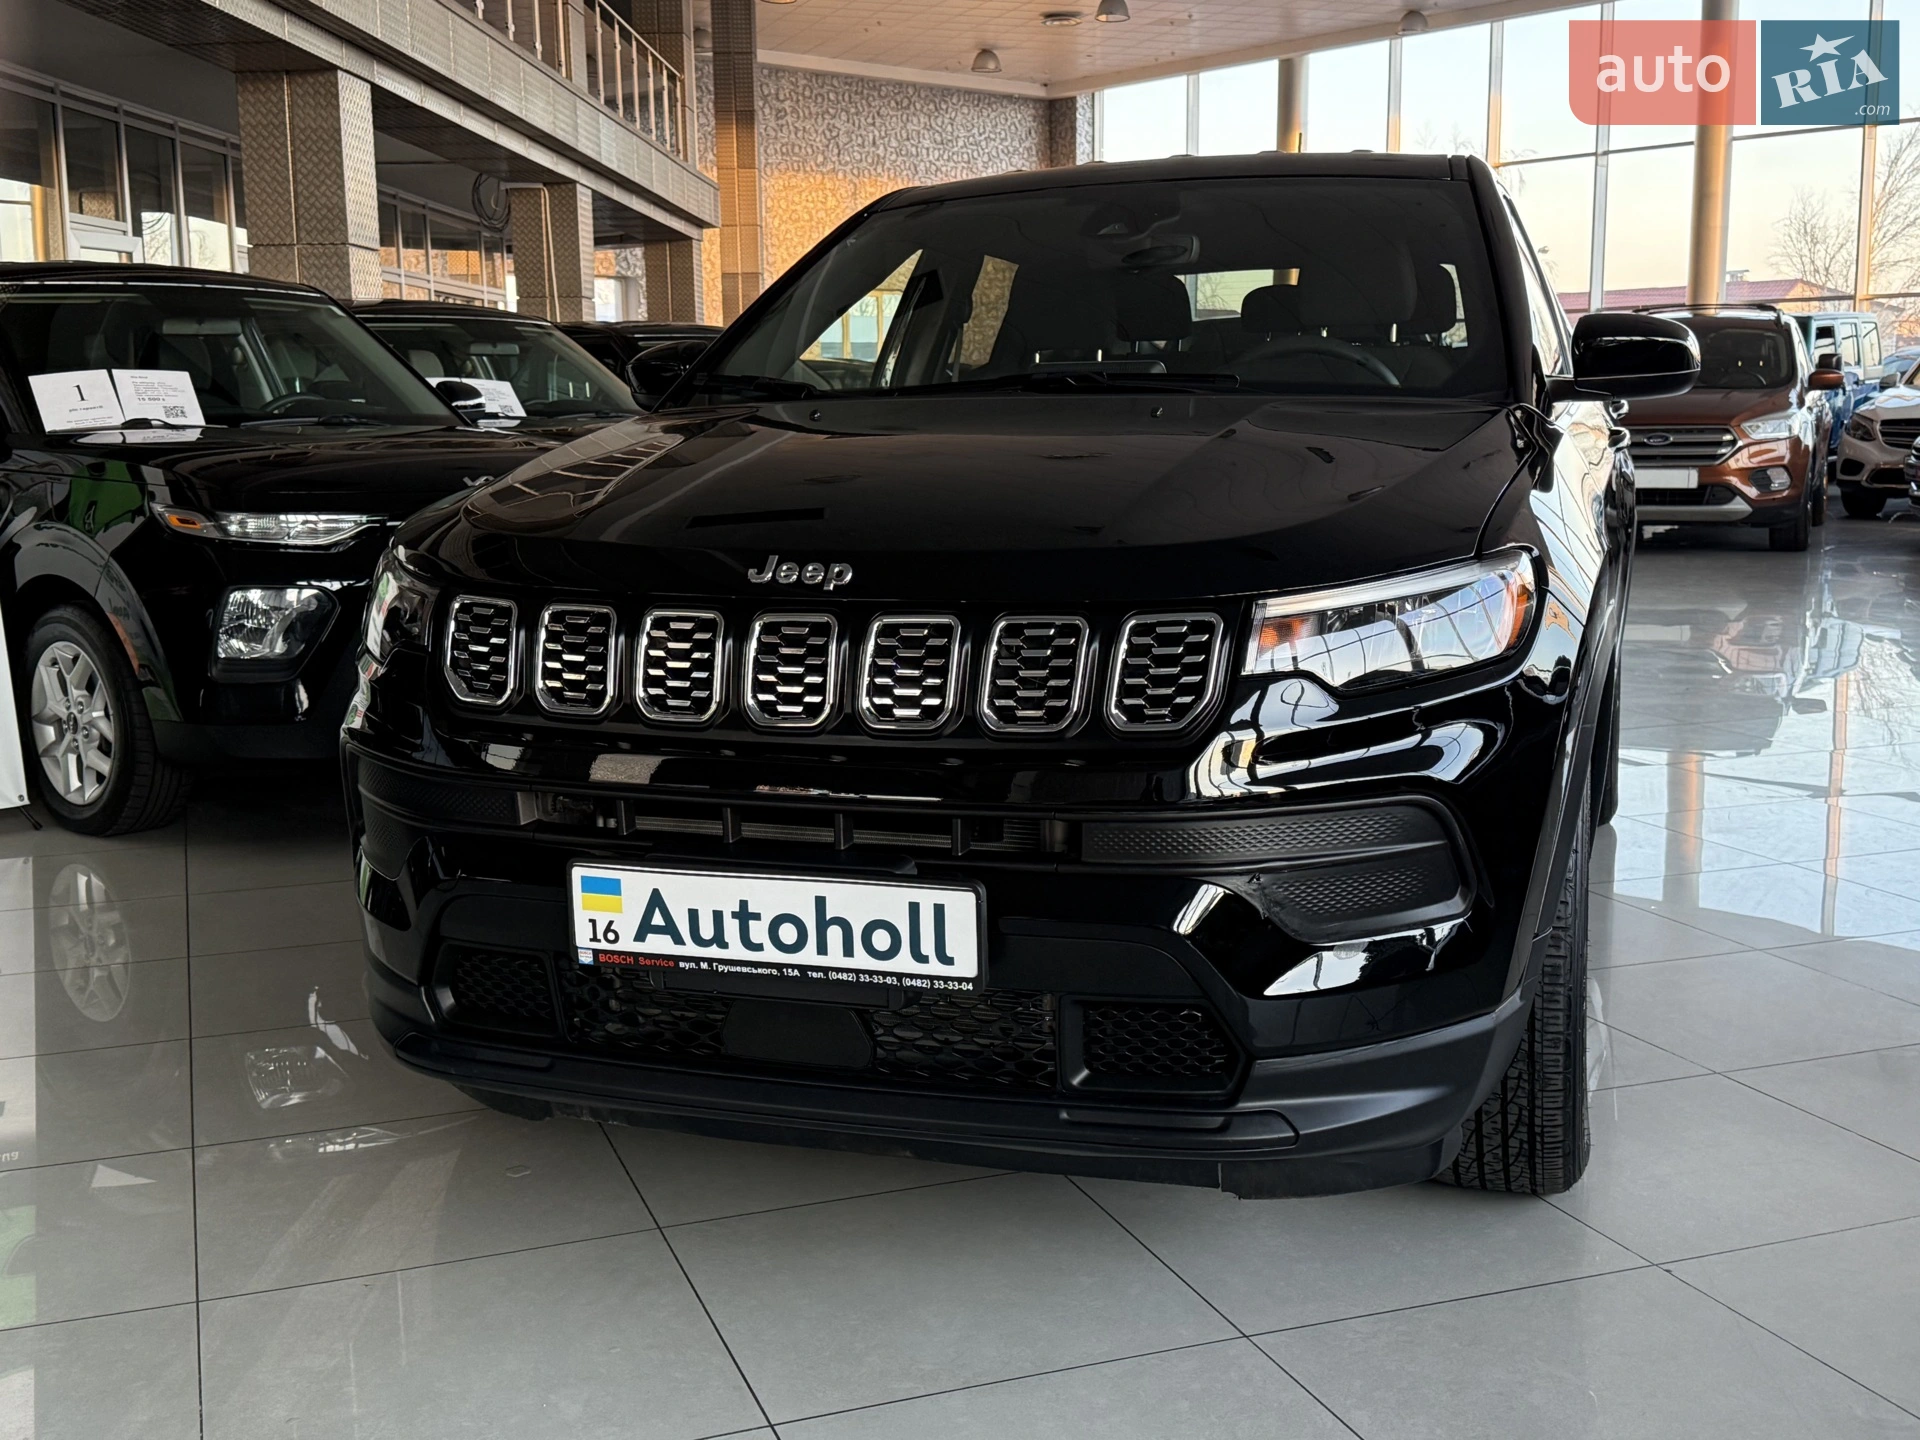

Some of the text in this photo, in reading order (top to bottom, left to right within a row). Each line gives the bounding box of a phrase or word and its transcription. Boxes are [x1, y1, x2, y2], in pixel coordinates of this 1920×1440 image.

[72, 384, 89, 402] 1
[747, 555, 853, 591] Jeep
[588, 918, 620, 945] 16
[632, 887, 955, 967] Autoholl
[598, 953, 634, 965] BOSCH
[638, 956, 675, 968] Service
[679, 960, 698, 969] вул.
[700, 961, 711, 970] М.
[713, 962, 780, 977] Грушевського,
[807, 971, 827, 979] тел.
[828, 970, 857, 983] (0482)
[858, 973, 900, 987] 33-33-03,
[902, 976, 931, 989] (0482)
[933, 979, 973, 991] 33-33-04
